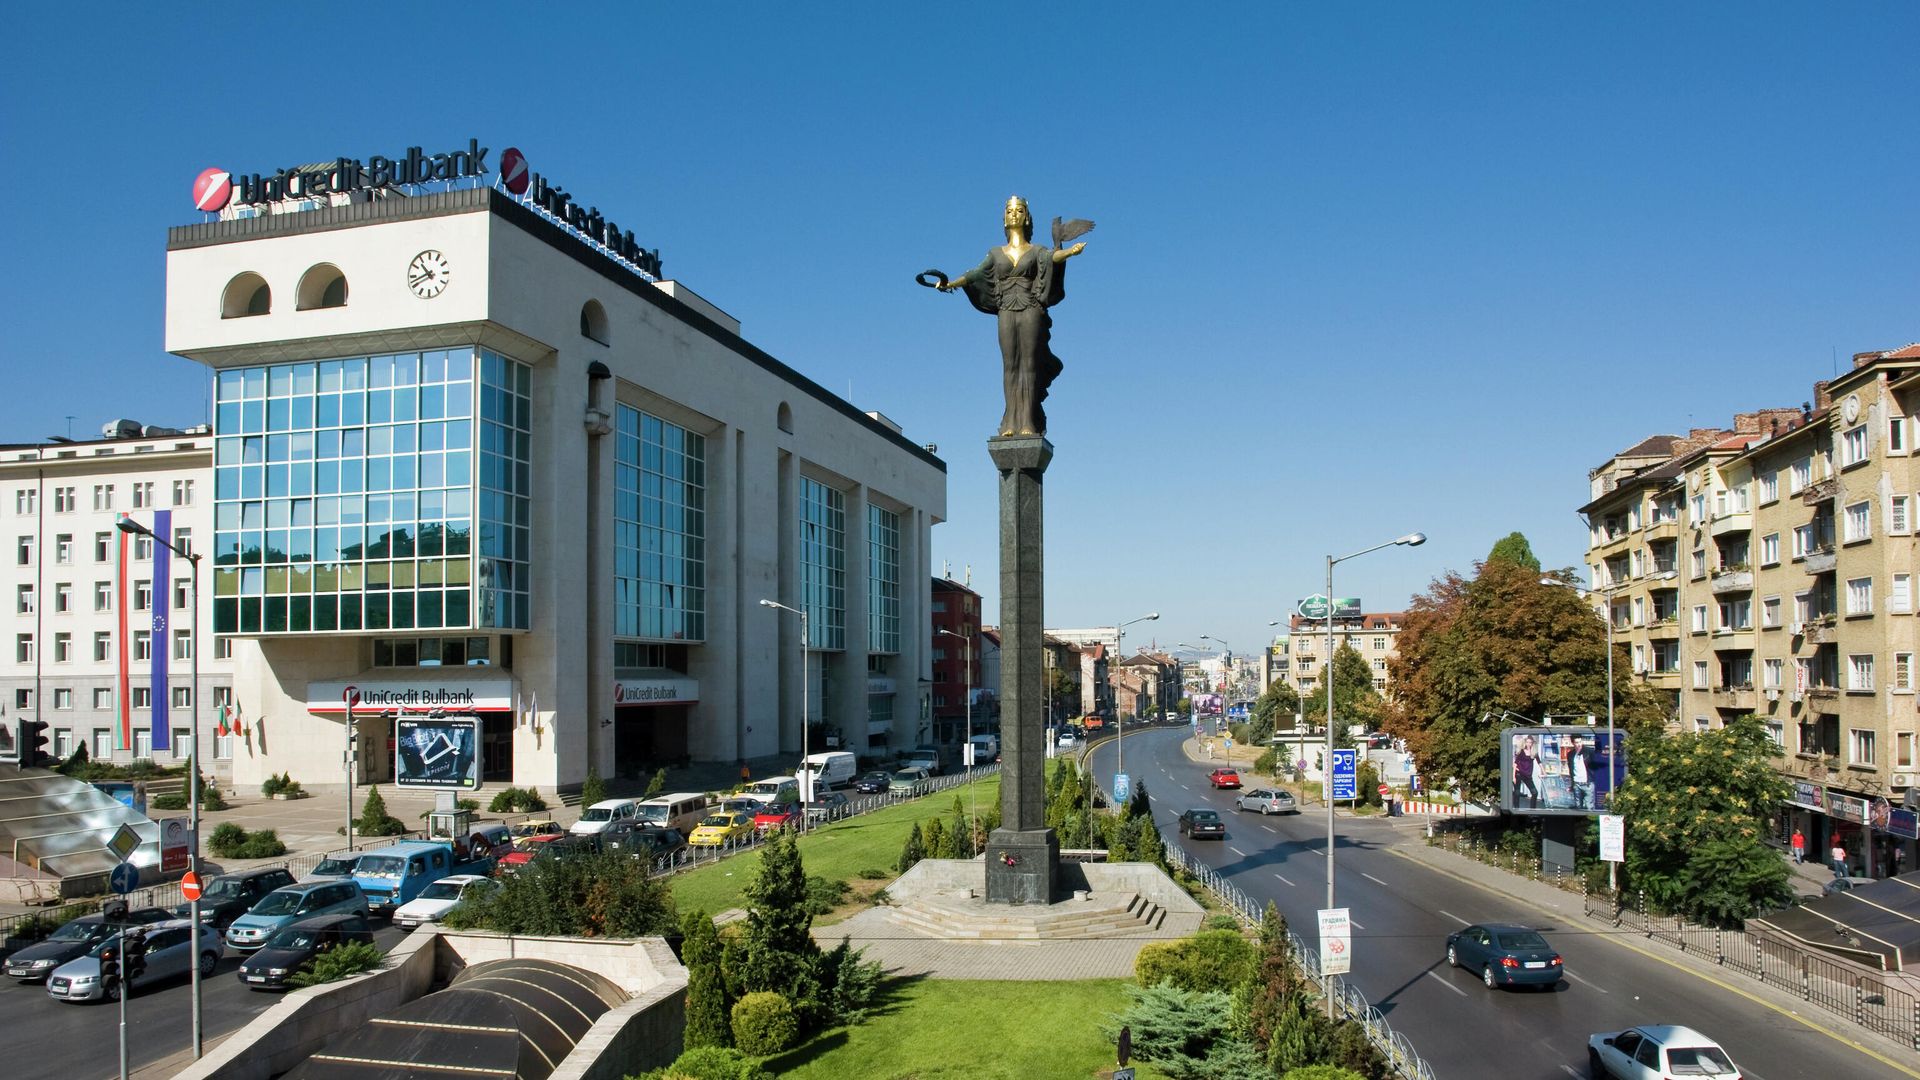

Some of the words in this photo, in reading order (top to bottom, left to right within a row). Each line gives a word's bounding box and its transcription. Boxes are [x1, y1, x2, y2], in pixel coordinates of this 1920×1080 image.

[240, 156, 364, 204] UniCredit
[368, 138, 490, 188] Bulbank
[363, 689, 419, 705] UniCredit
[422, 688, 475, 704] Bulbank
[625, 686, 653, 701] UniCredit
[653, 685, 678, 700] Bulbank
[1833, 800, 1842, 811] ART
[1842, 801, 1863, 816] CENTER
